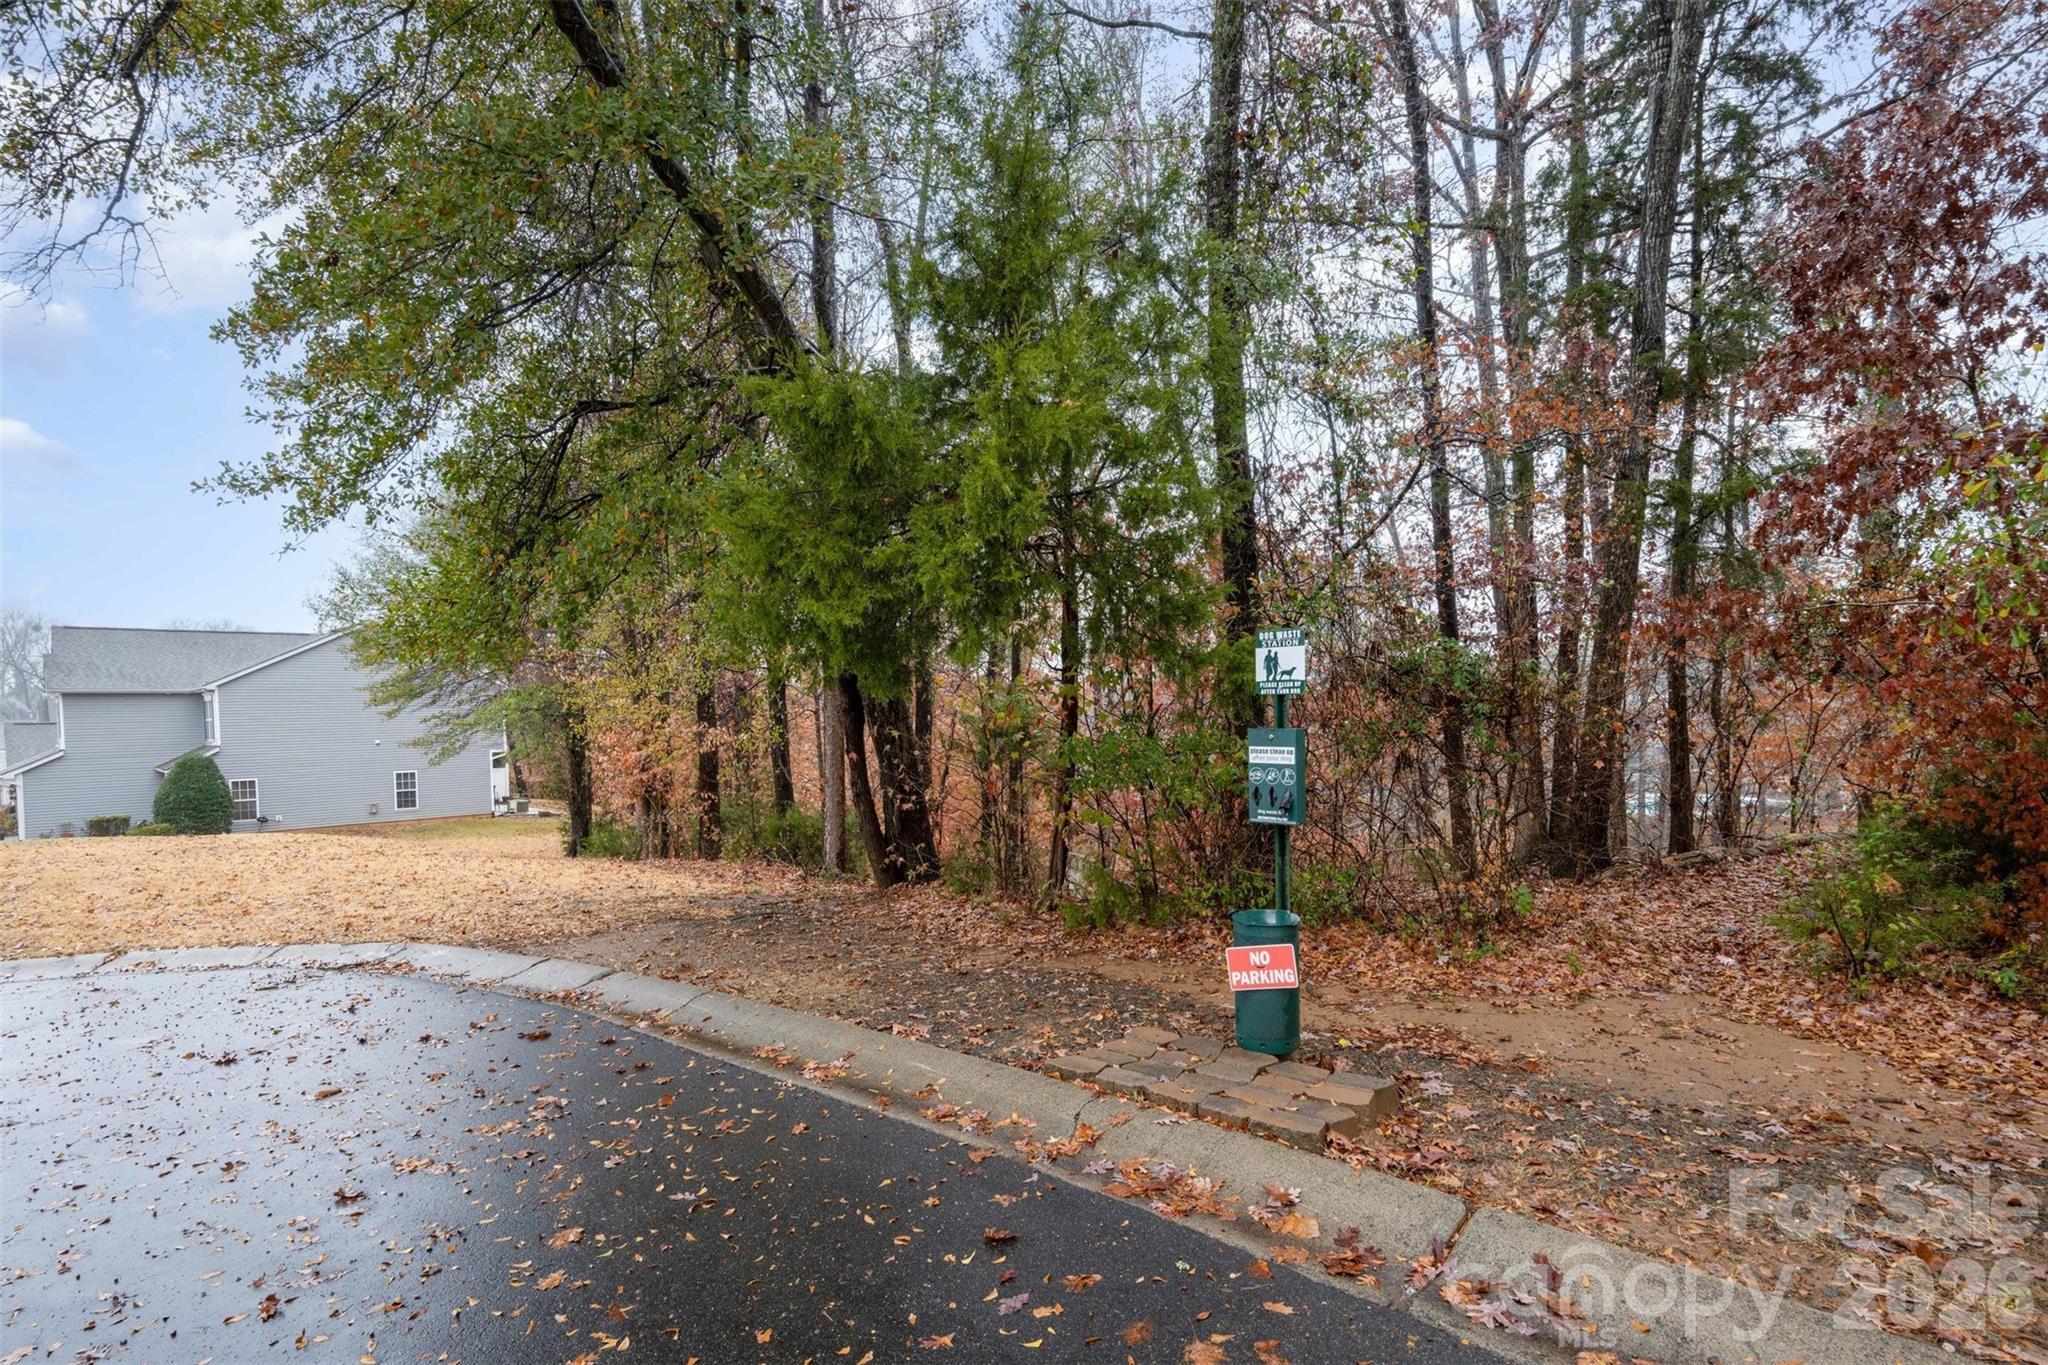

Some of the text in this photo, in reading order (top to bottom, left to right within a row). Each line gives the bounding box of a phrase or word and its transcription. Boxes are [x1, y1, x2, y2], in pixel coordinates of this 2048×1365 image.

[1259, 630, 1301, 640] DOG WASTE
[1262, 639, 1299, 647] STATION
[1280, 755, 1292, 763] dog
[1249, 951, 1270, 966] NO
[1231, 969, 1295, 985] PARKING
